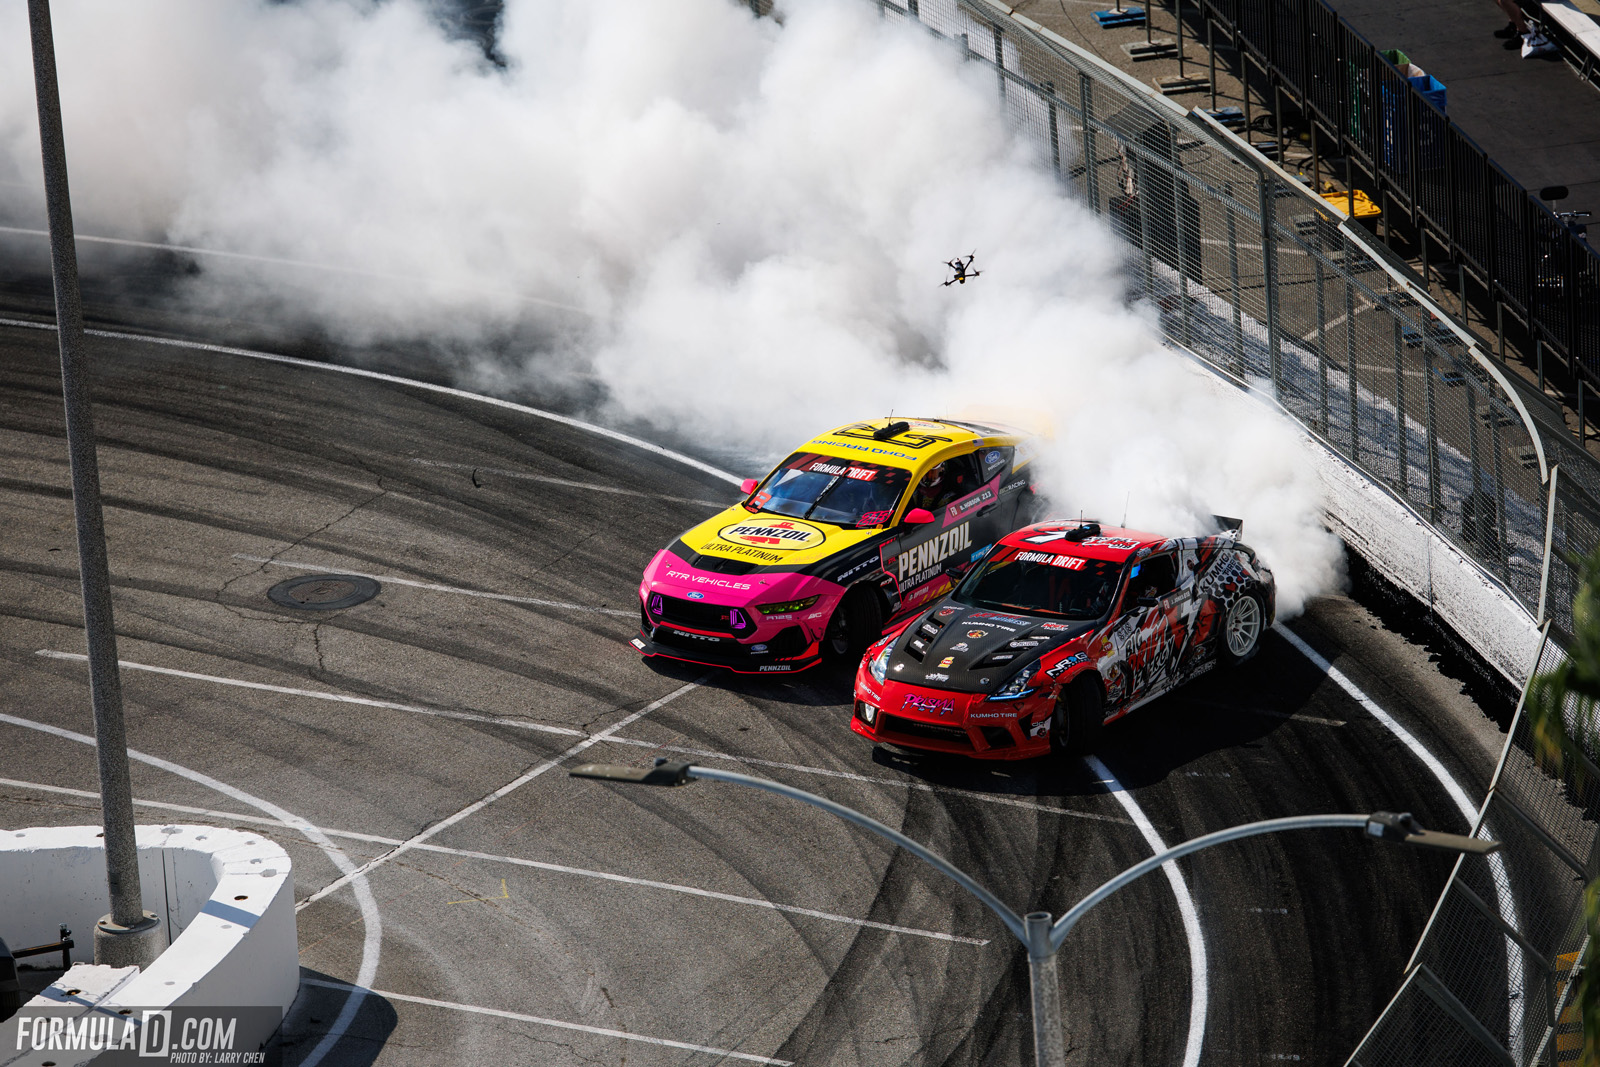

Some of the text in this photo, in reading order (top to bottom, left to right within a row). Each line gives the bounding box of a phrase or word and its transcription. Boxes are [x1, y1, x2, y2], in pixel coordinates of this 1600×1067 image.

[811, 439, 917, 461] FORD RACING
[808, 462, 876, 481] FORMULA DRIFT
[981, 490, 992, 501] 213
[728, 526, 811, 542] PENNZOIL
[701, 543, 729, 553] ULTRA
[730, 546, 783, 563] PLATINUM
[898, 521, 972, 582] PENNZOIL
[1014, 552, 1086, 569] FORMULA DRIFT
[837, 555, 880, 582] NITTO
[1200, 553, 1230, 593] KUMHO
[1222, 559, 1237, 576] TIRE
[666, 570, 751, 591] RTR VEHICLES
[898, 576, 915, 593] ULTRA
[914, 562, 942, 586] PLATINUM
[673, 630, 720, 642] NITTO
[995, 624, 1016, 633] TIRE
[871, 690, 881, 702] TIRE
